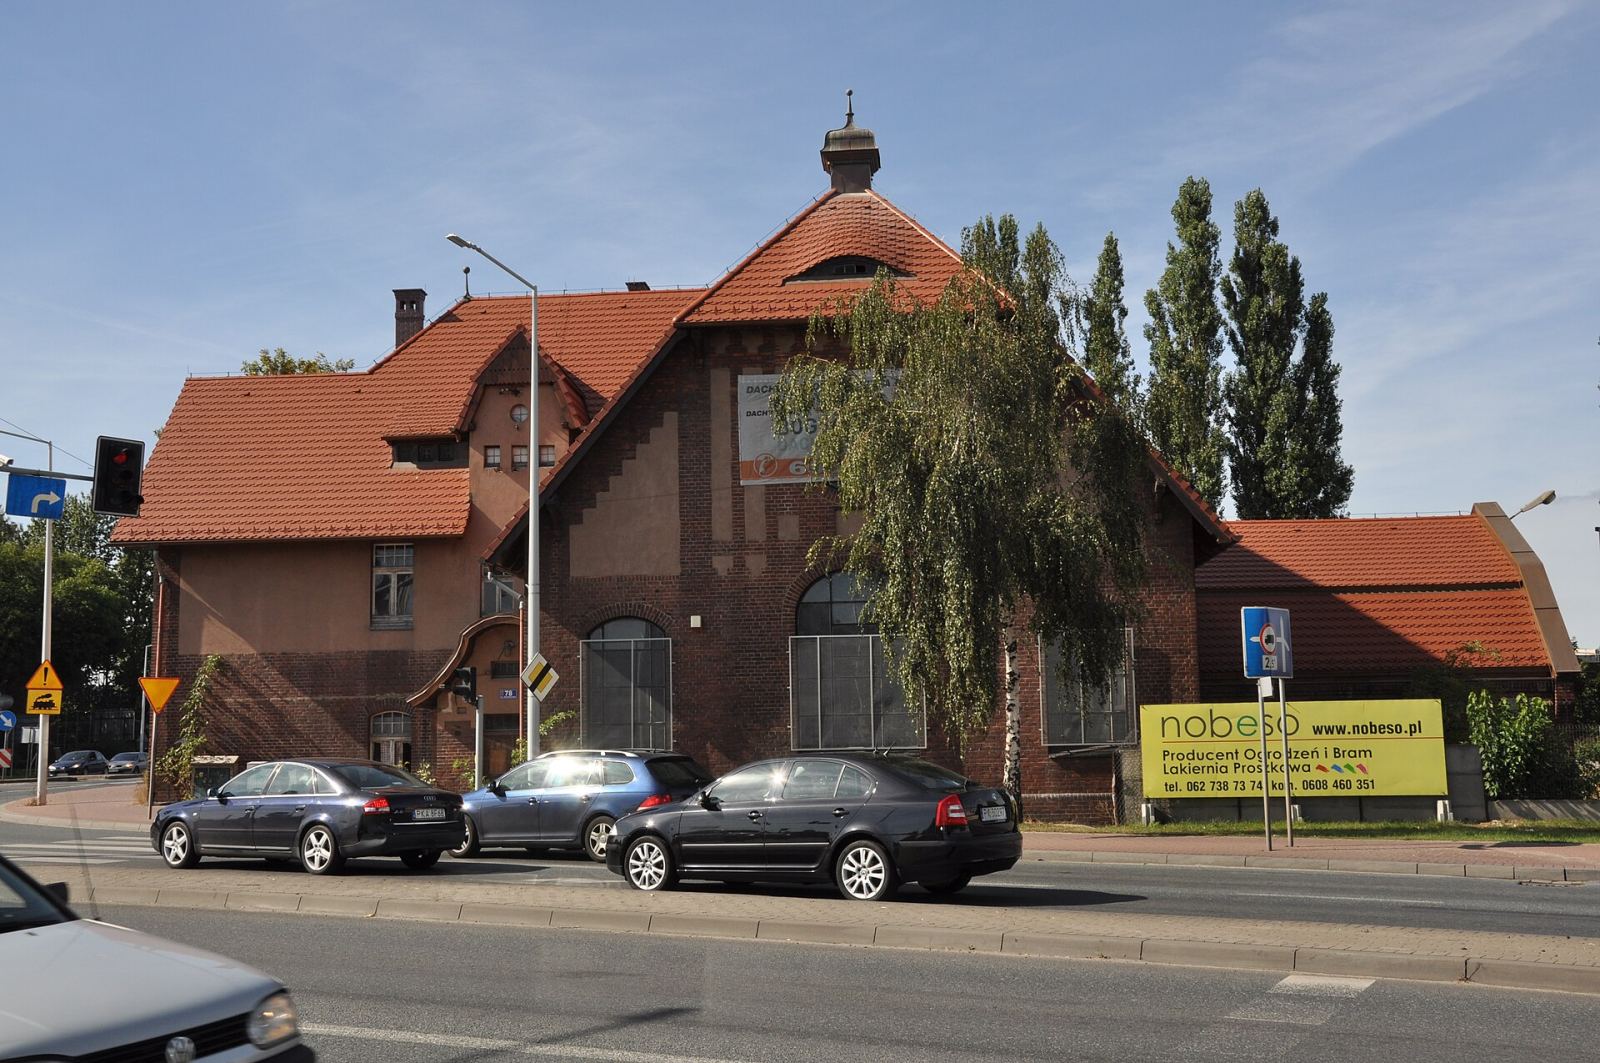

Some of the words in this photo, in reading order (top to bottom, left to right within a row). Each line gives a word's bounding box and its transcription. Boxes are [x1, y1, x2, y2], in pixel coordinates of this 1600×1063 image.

[1161, 708, 1300, 738] nobeso
[1312, 720, 1422, 736] www.nobeso.pl
[1162, 749, 1239, 761] Producent
[1324, 747, 1328, 759] i
[1333, 747, 1373, 759] Bram
[1163, 762, 1229, 775] Lakiernia
[1164, 781, 1182, 792] tel.
[1186, 781, 1206, 792] 062
[1210, 781, 1229, 791] 738
[1233, 780, 1246, 791] 73
[1250, 780, 1263, 791] 74
[1302, 779, 1328, 790] 0608
[1332, 779, 1352, 790] 460
[1356, 779, 1375, 790] 351
